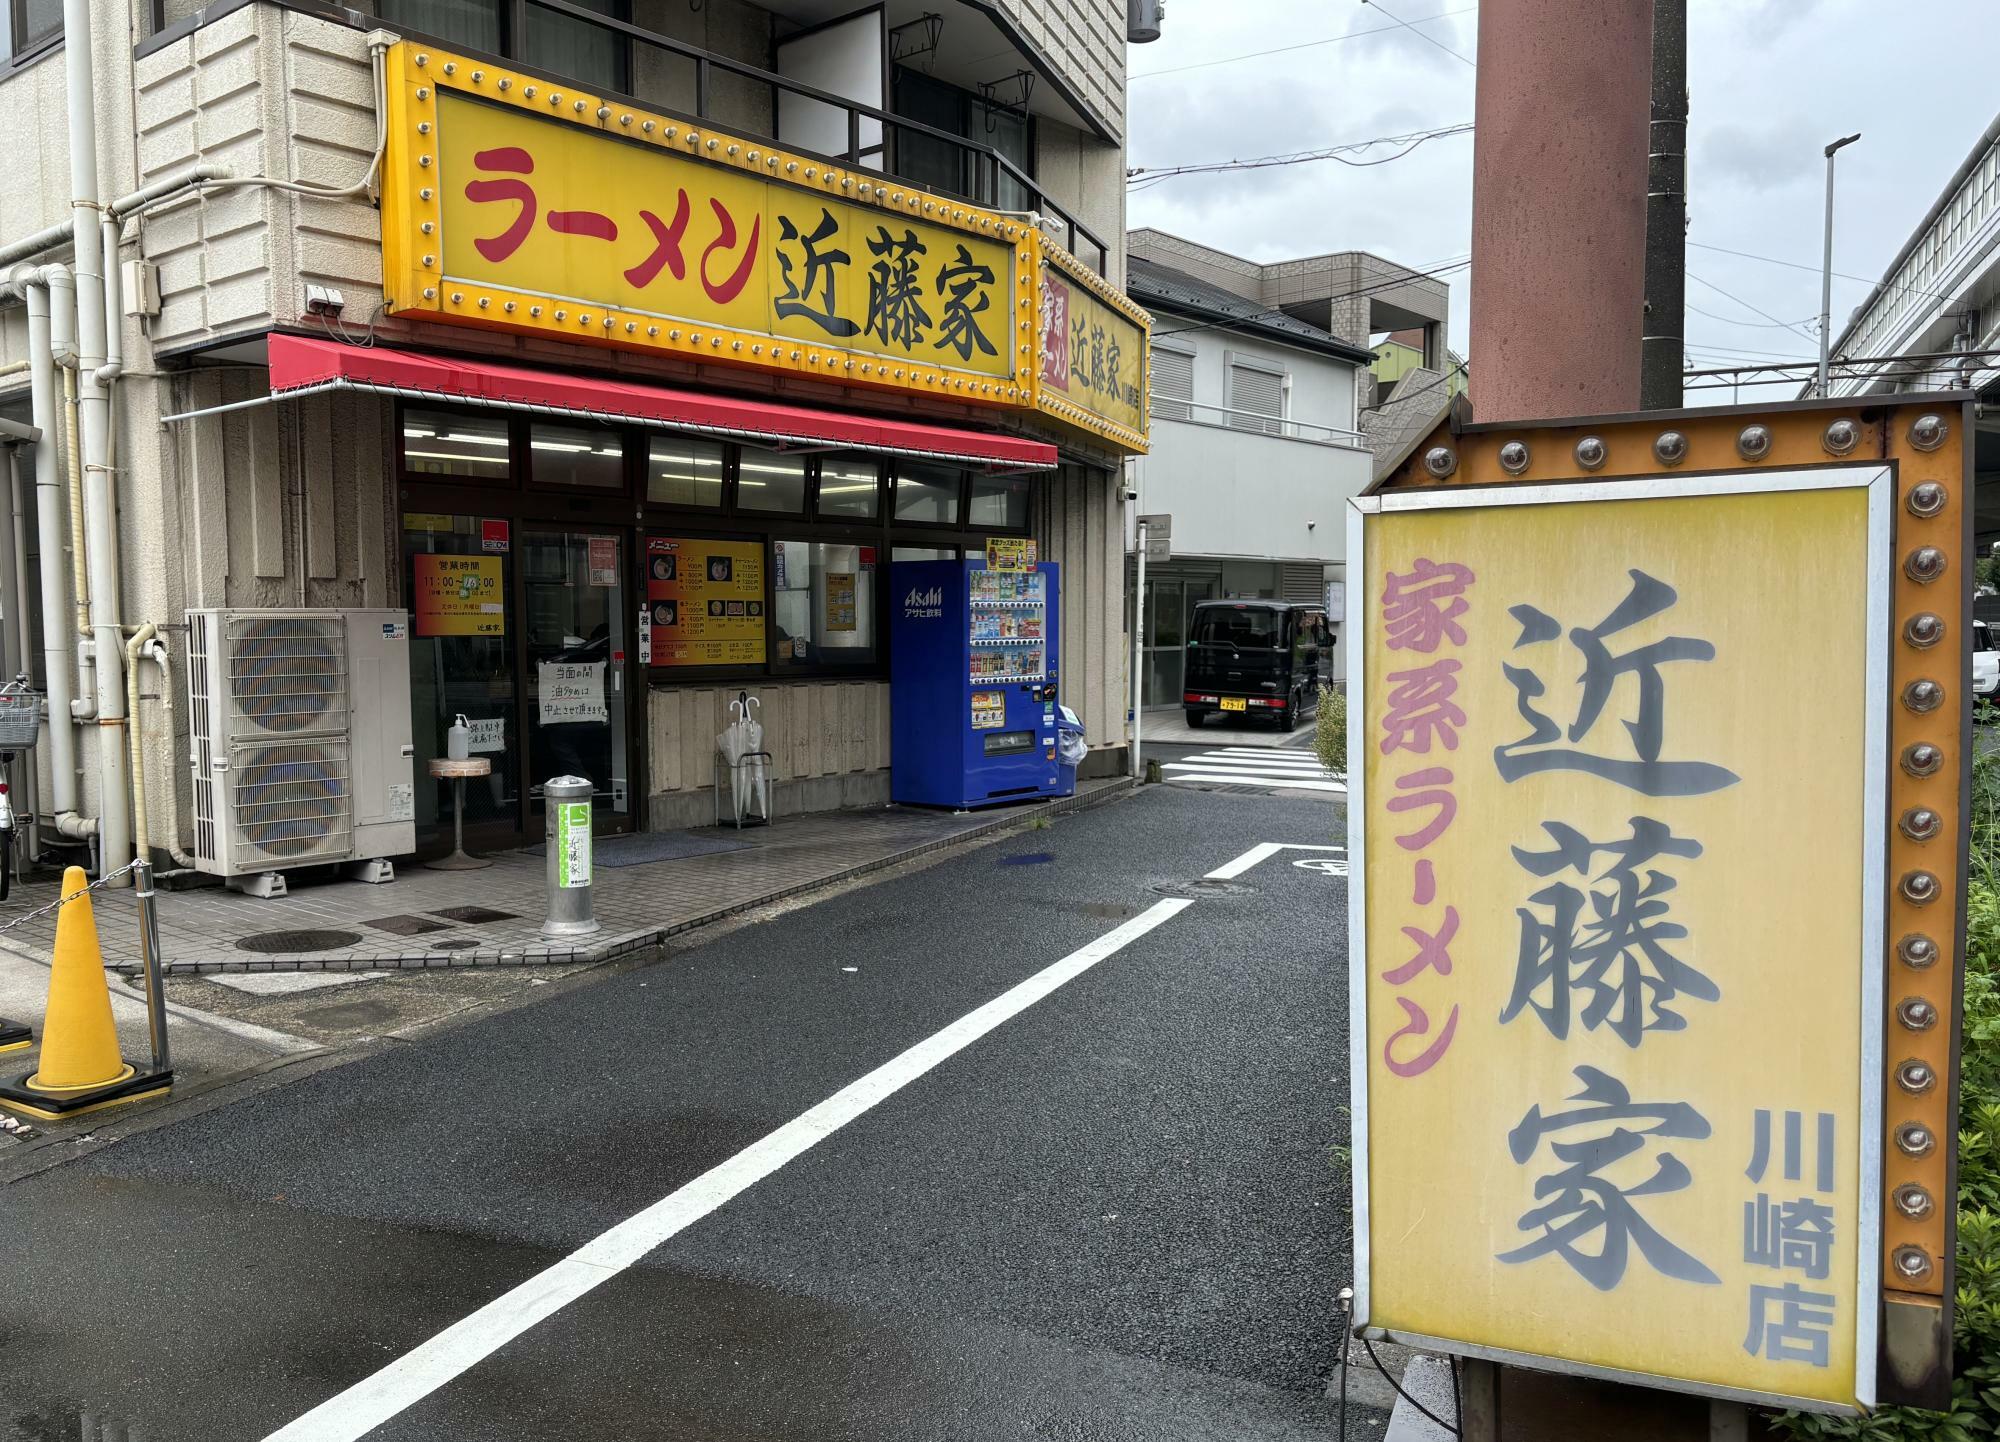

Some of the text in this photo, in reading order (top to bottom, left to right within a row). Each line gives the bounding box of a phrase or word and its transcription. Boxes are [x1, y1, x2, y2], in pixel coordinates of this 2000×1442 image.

[465, 147, 998, 361] ラーメン 近藤家
[1071, 312, 1121, 402] 近藤家
[1121, 381, 1139, 410] 川崎店
[649, 540, 679, 550] メニュー
[438, 560, 480, 571] 営業時間
[904, 586, 942, 607] Asahi
[904, 608, 942, 618] アサヒ飲料
[640, 615, 650, 662] 営業中
[556, 665, 593, 680] 当面の間
[1379, 557, 1477, 1078] 家系ラーメン
[1493, 568, 1742, 1291] 近藤家
[1743, 1108, 1838, 1368] 川崎店
